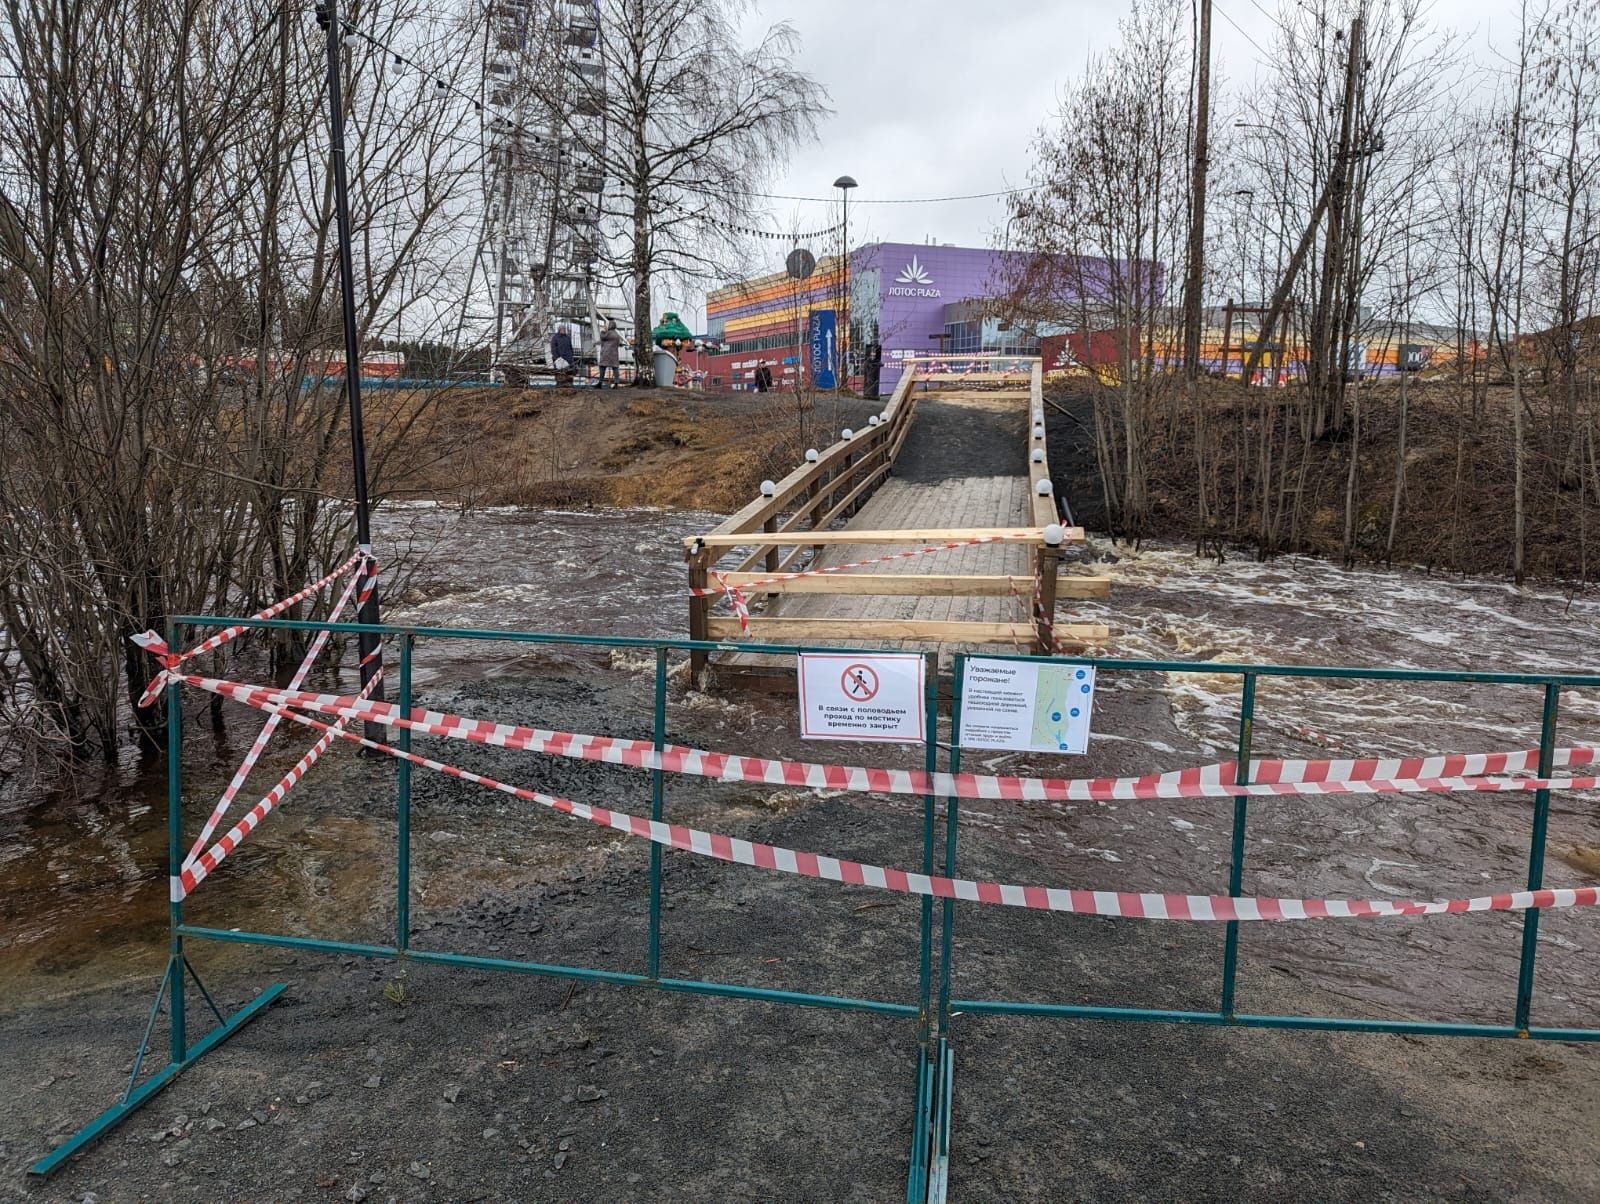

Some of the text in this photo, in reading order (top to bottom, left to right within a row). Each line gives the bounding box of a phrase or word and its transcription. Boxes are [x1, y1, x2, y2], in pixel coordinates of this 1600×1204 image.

[889, 287, 941, 298] ЛОТОС PLAZA
[812, 314, 822, 373] ЛОТОС PLAZA
[970, 665, 1017, 676] Уважаемые
[969, 675, 1011, 685] горожане!
[828, 721, 867, 729] временно
